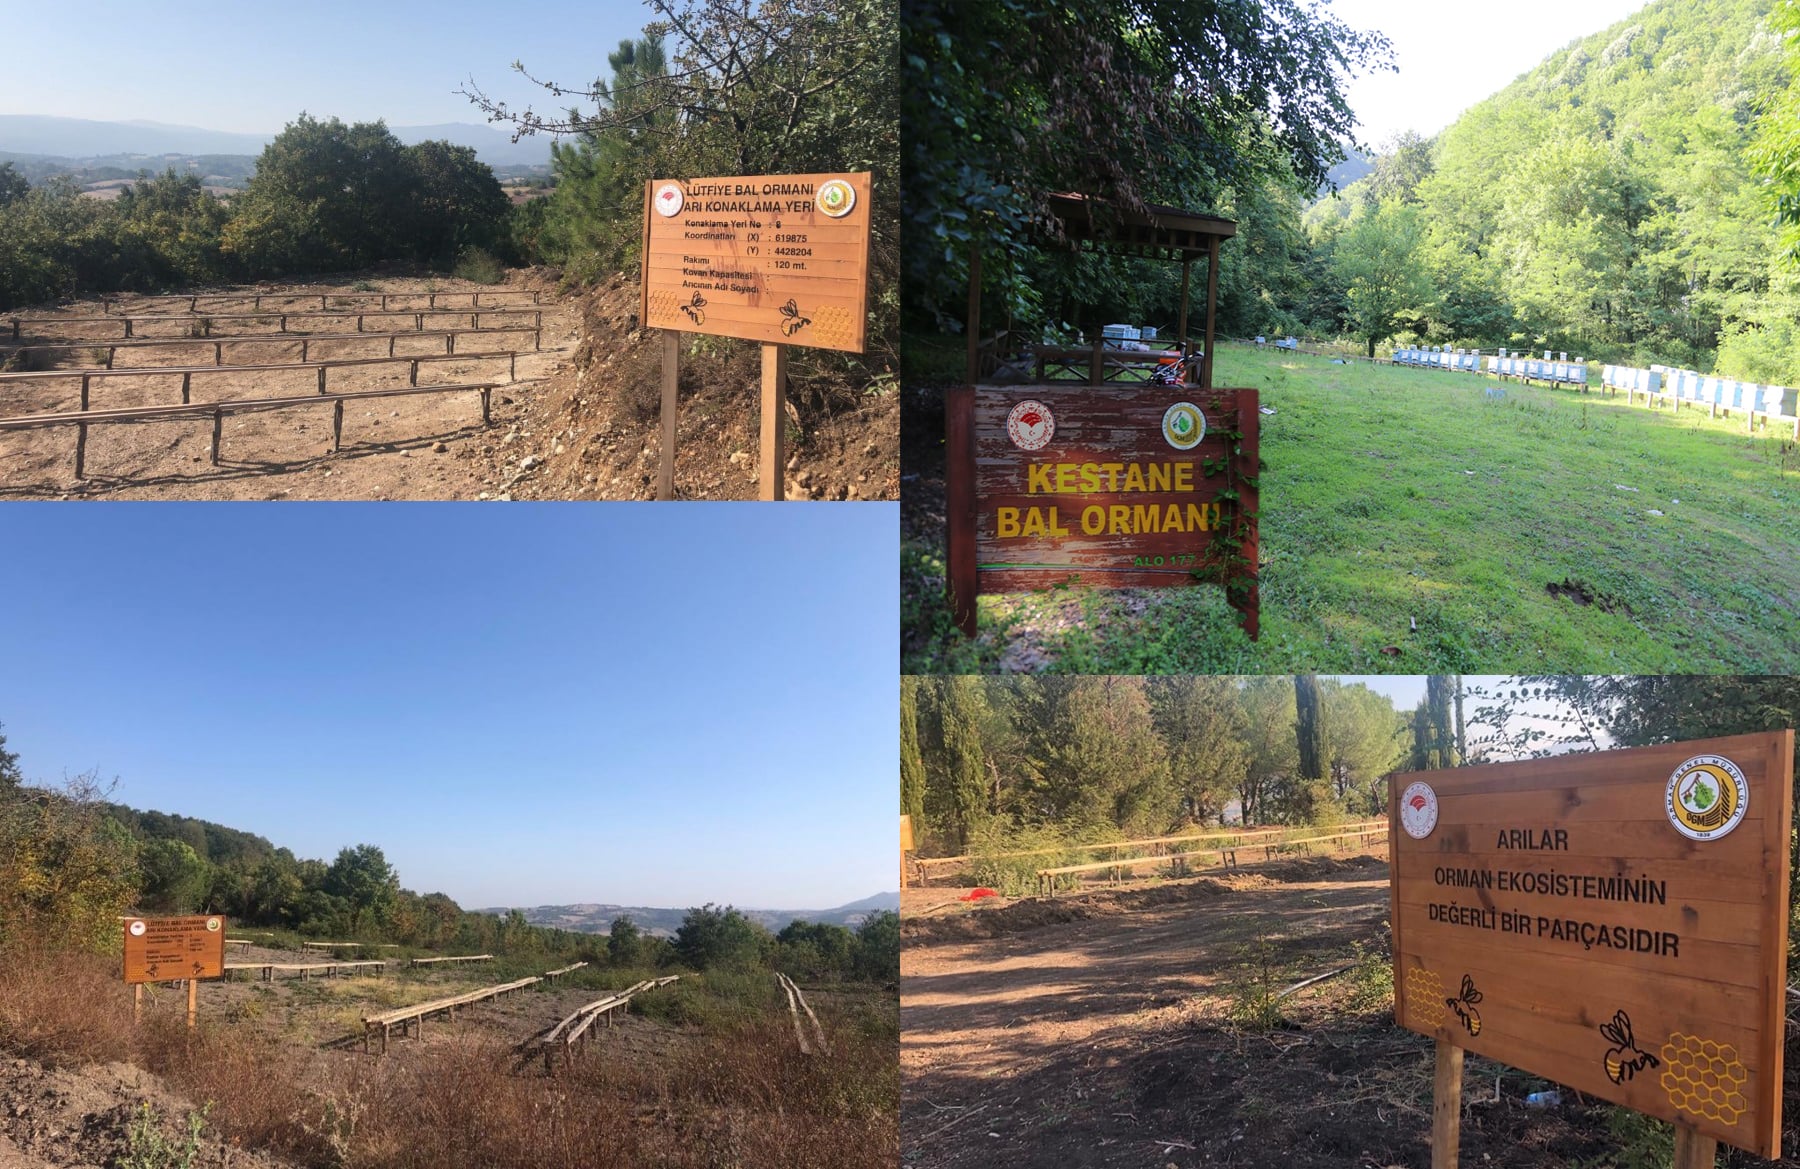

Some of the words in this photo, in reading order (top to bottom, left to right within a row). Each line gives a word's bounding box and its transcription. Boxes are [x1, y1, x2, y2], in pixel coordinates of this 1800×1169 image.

[686, 182, 732, 196] LÜTFİYE
[735, 185, 758, 196] BAL
[762, 184, 814, 196] ORMANI
[684, 202, 702, 212] ARI
[705, 201, 782, 212] KONAKLAMA
[786, 198, 814, 212] YERİ
[685, 220, 729, 228] Konaklama
[730, 220, 747, 228] Yeri
[684, 231, 736, 240] Koordinatları
[748, 234, 760, 242] (X)
[776, 234, 808, 242] 619875
[746, 246, 759, 256] (Y)
[774, 248, 812, 256] 4428204
[683, 256, 710, 264] Rakımı
[774, 261, 790, 269] 120
[792, 262, 807, 270] mt.
[682, 268, 708, 276] Kovan
[714, 282, 728, 290] Adı
[730, 282, 759, 294] Soyadı
[1028, 462, 1194, 494] KESTANE
[997, 506, 1068, 538] BAL
[1081, 503, 1220, 535] ORMANI
[1134, 556, 1164, 566] ALO
[1170, 554, 1196, 566] 177
[1676, 758, 1706, 778] GENEL
[1686, 812, 1705, 826] OGM
[1496, 829, 1569, 852] ARILAR
[1434, 866, 1492, 890] ORMAN
[1497, 869, 1666, 905] EKOSİSTEMİNİN
[1429, 900, 1496, 930] DEĞERLİ
[1500, 908, 1532, 936] BİR
[1538, 917, 1680, 958] PARÇASIDIR
